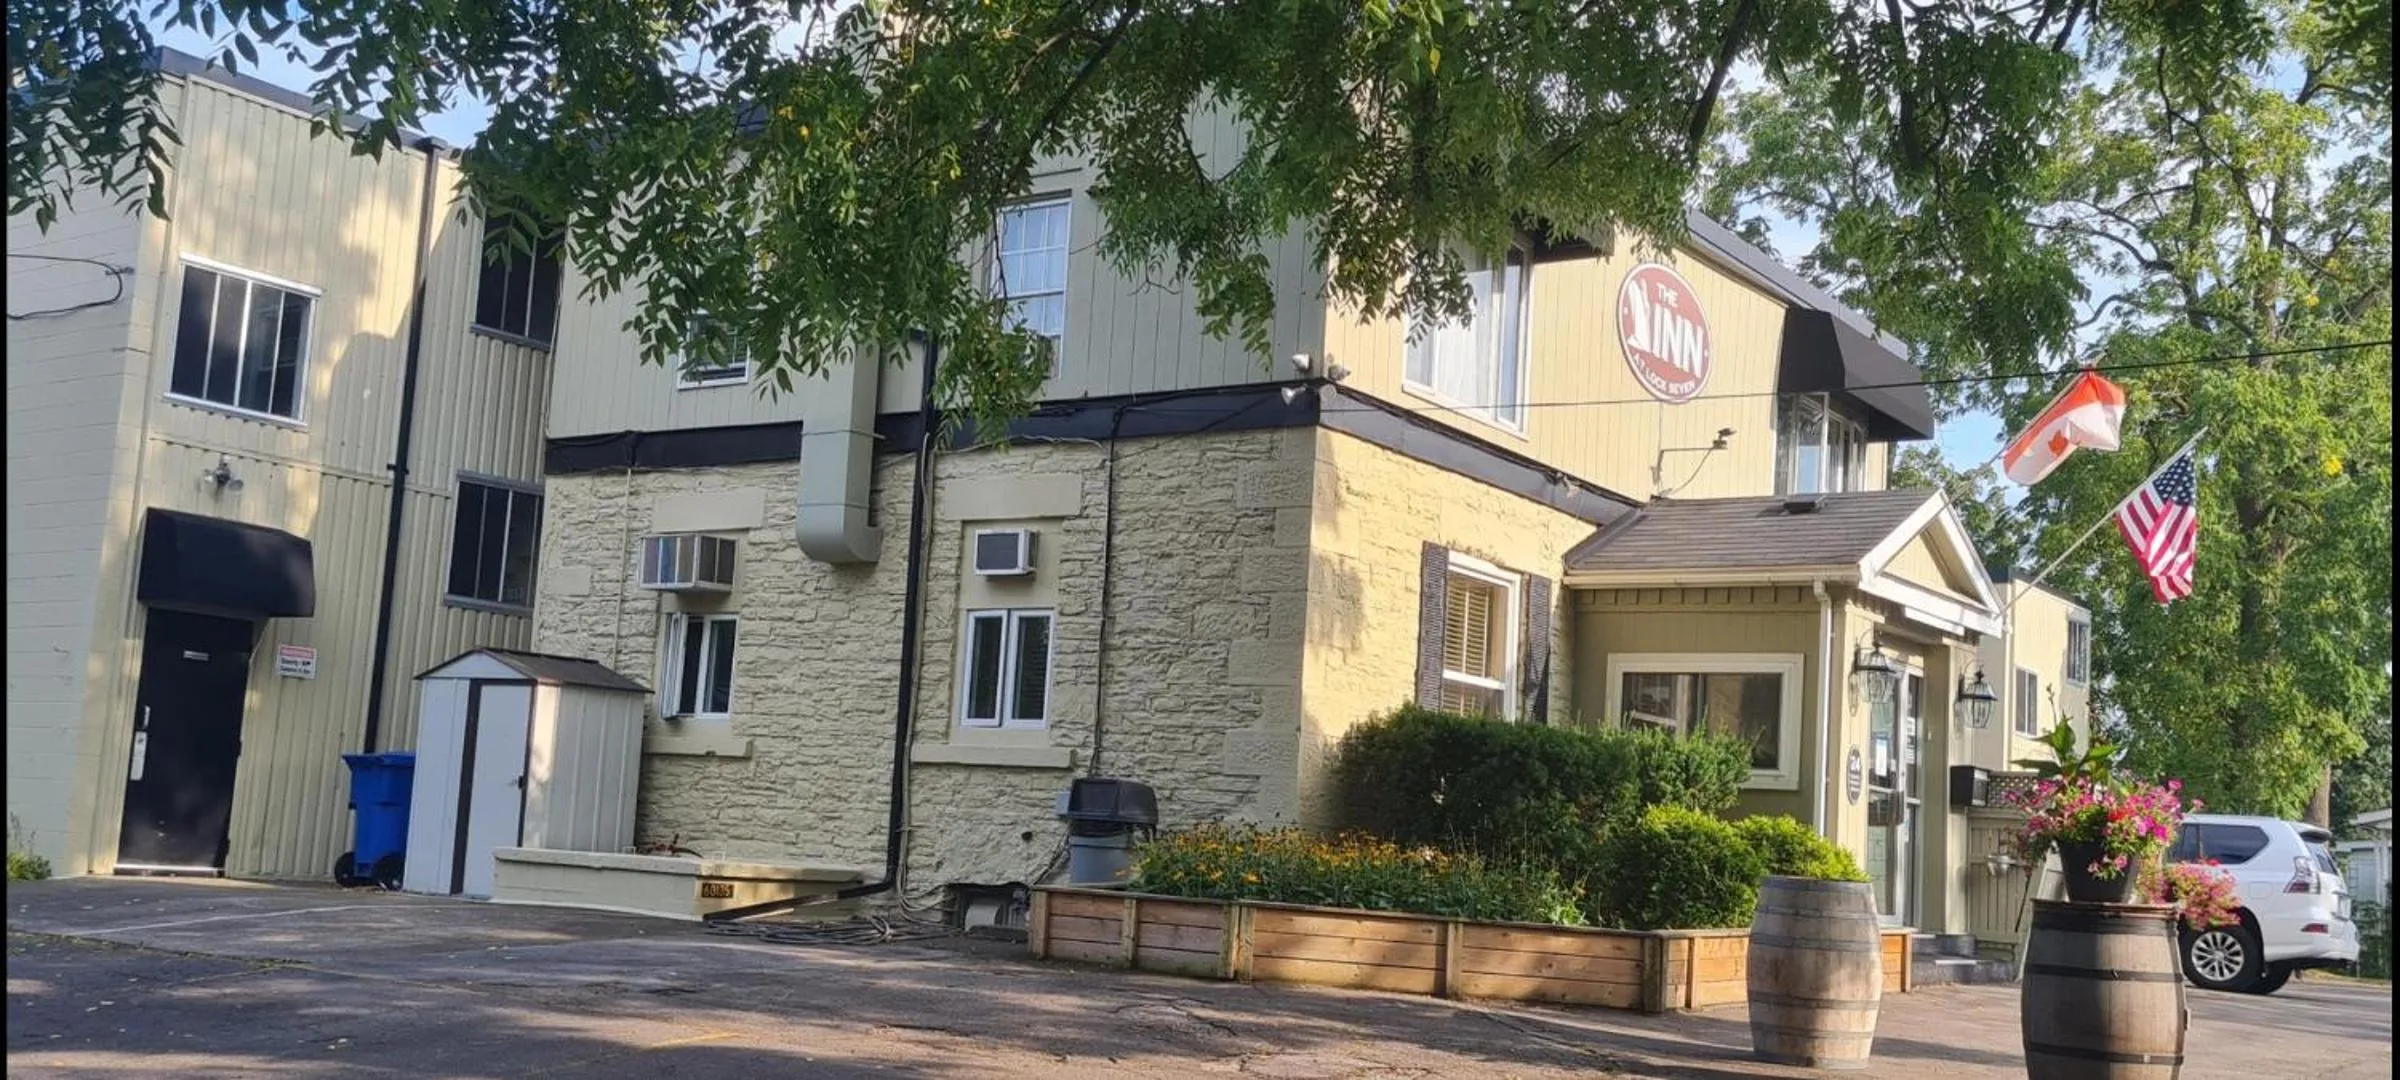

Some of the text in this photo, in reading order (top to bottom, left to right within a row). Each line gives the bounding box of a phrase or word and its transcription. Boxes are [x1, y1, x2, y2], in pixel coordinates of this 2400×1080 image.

[1656, 281, 1678, 308] THE
[1653, 303, 1704, 379] INN
[1633, 352, 1696, 394] AT LOCK SEVEN
